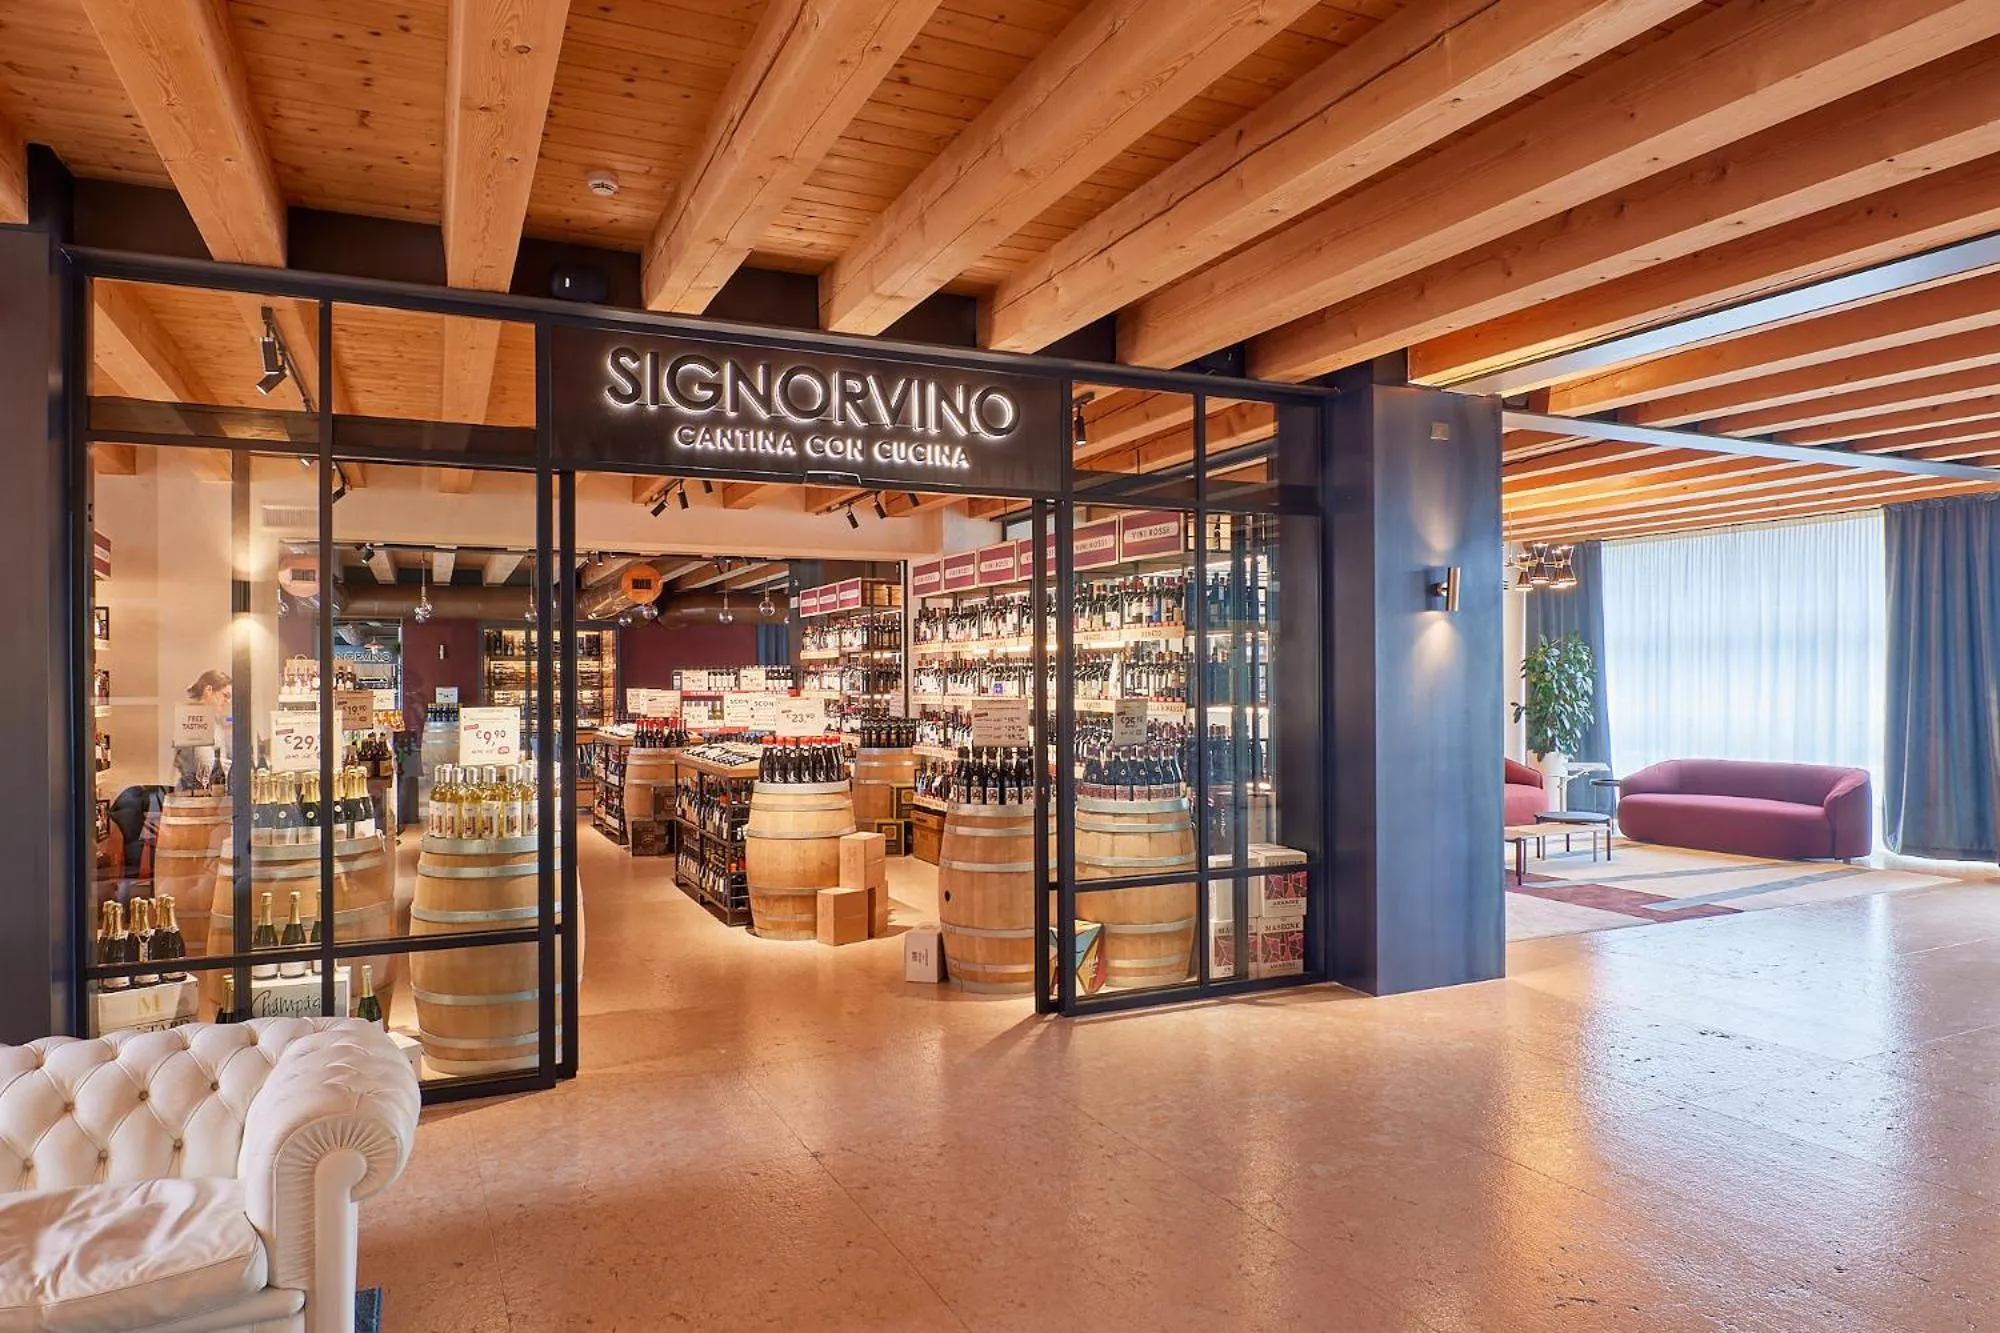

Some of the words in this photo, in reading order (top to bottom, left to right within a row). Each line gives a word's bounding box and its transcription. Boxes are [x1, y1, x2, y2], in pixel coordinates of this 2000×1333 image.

[604, 347, 1021, 438] SIGNORVINO
[674, 425, 796, 456] CANTINA
[806, 437, 864, 462] CON
[873, 441, 970, 468] CUCINA
[182, 723, 209, 731] TASTING
[187, 715, 204, 723] FREE
[476, 730, 506, 746] €9,90
[136, 993, 161, 1015] M
